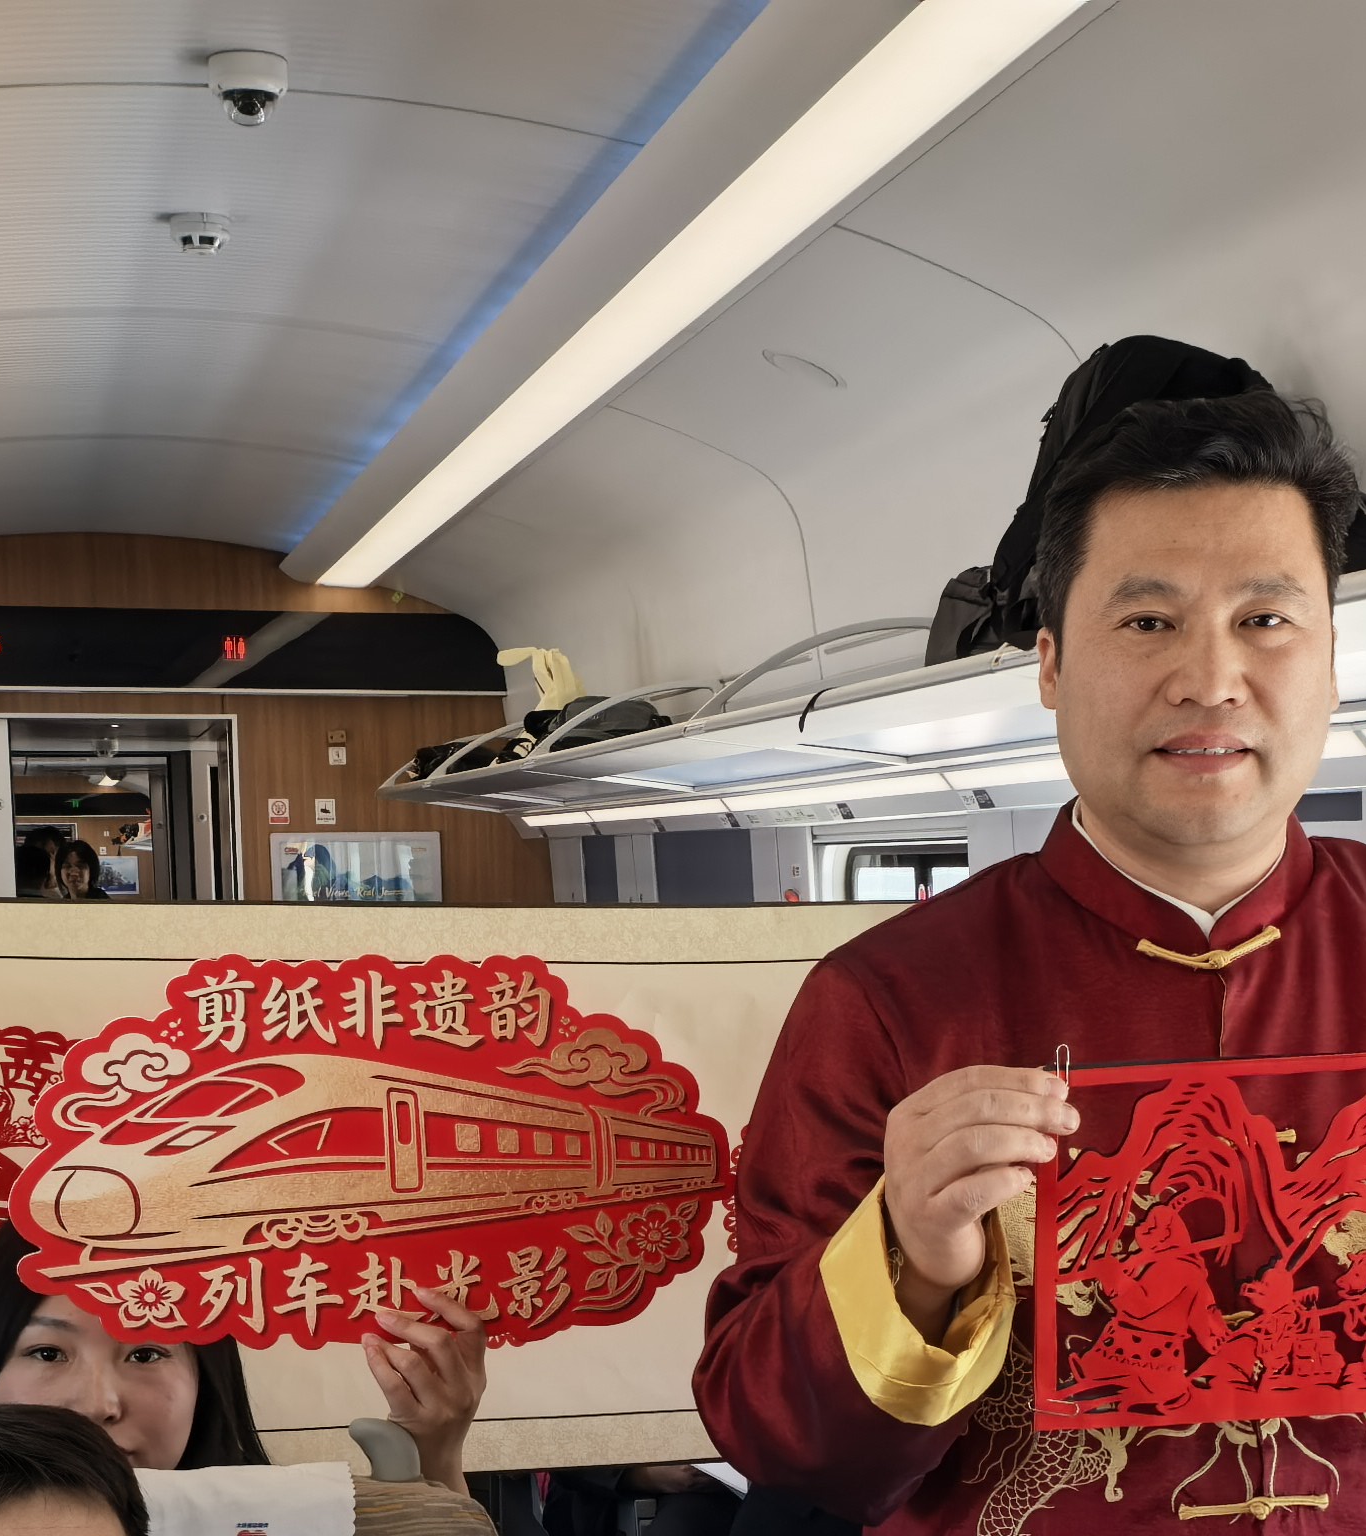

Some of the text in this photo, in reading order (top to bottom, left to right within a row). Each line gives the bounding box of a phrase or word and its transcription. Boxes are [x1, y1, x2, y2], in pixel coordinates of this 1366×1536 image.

[183, 969, 551, 1053] 剪纸非遗韵
[197, 1245, 571, 1338] 列车赴光影
